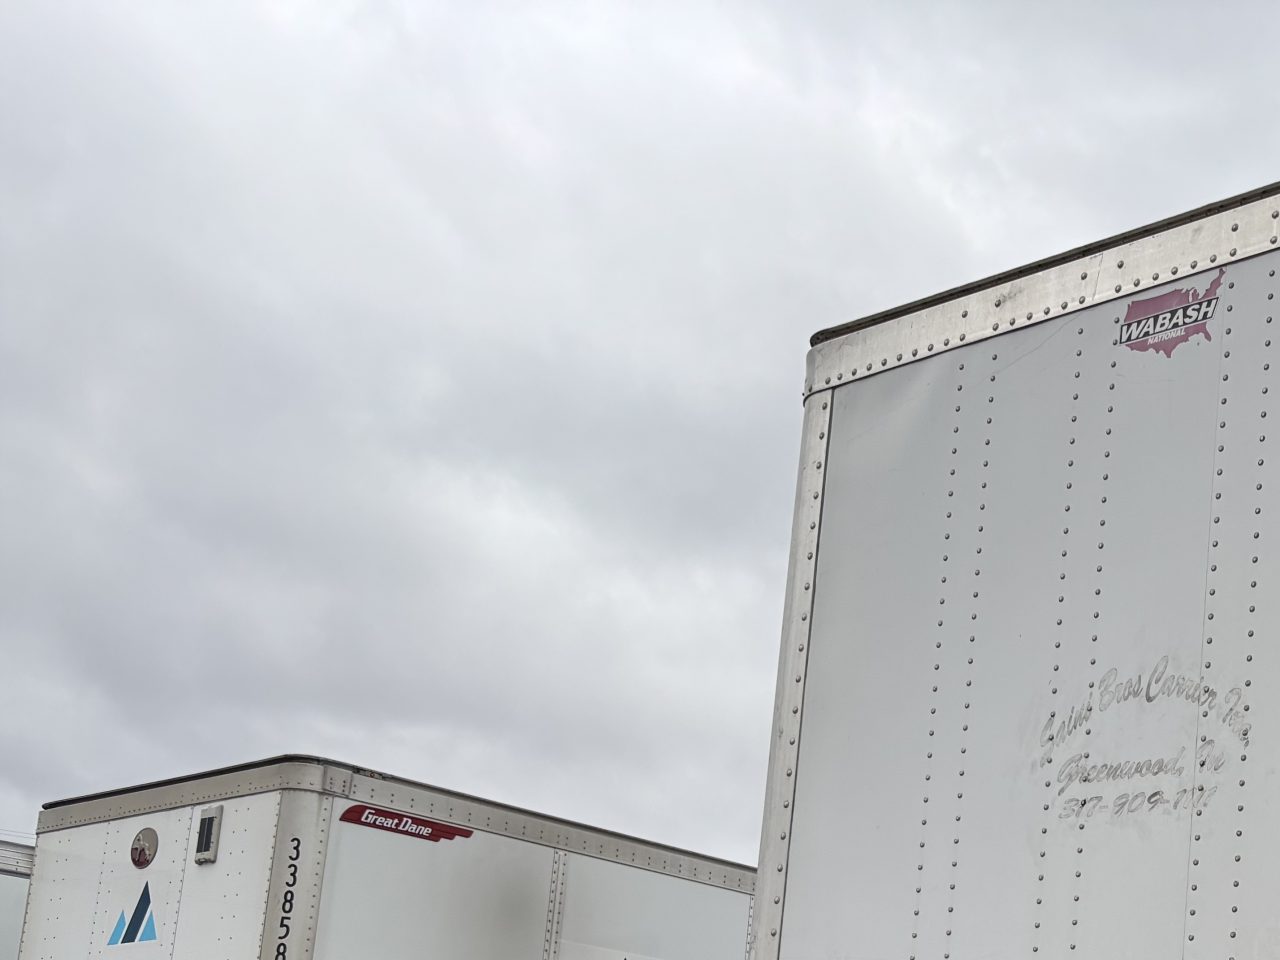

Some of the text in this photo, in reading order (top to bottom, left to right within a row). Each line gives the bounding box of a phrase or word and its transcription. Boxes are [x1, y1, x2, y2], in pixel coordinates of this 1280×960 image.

[1120, 298, 1217, 343] WABASH
[1147, 328, 1186, 345] NATIONAL
[361, 808, 432, 837] Great Dane
